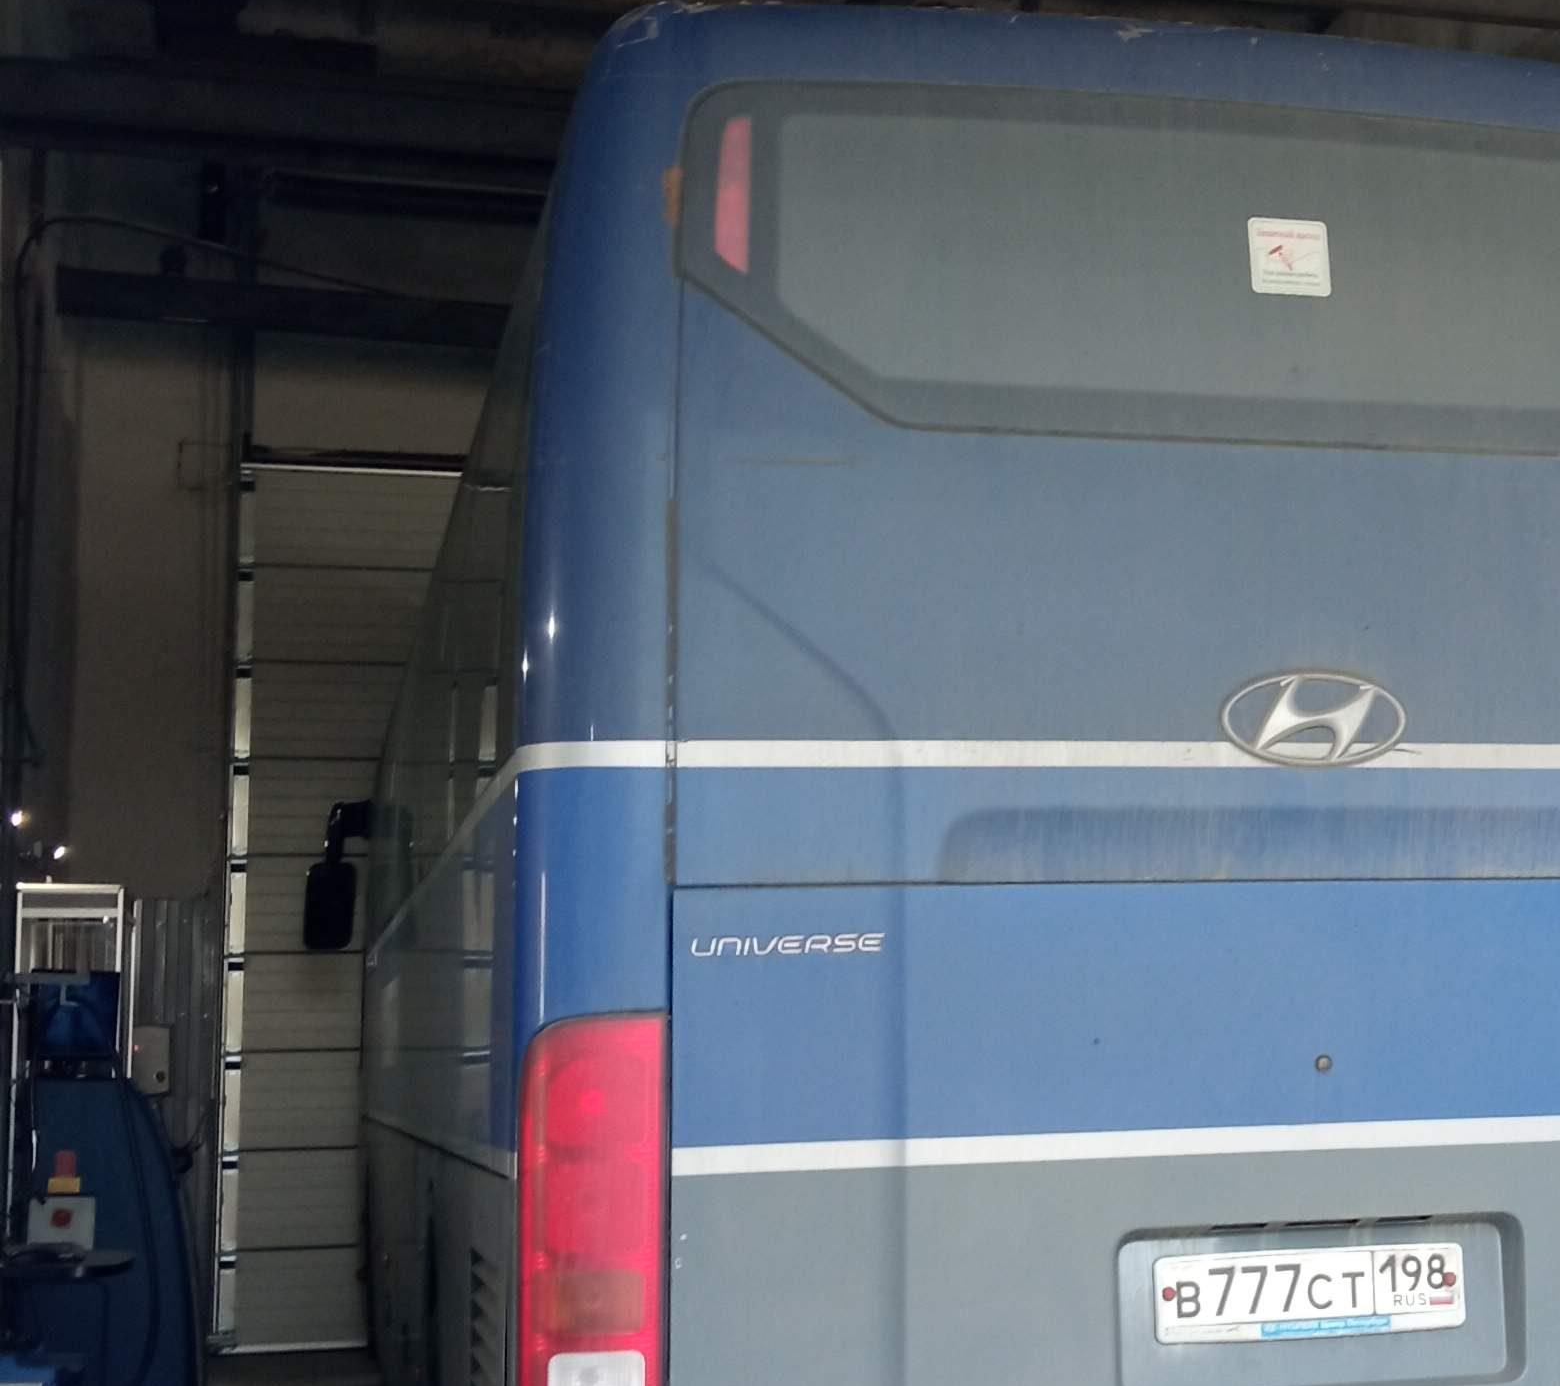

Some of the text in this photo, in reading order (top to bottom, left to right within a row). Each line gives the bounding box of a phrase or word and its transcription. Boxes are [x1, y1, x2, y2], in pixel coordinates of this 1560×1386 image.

[691, 932, 886, 957] UNIVERSE
[1378, 1253, 1446, 1293] 198
[1393, 1293, 1427, 1307] RUS
